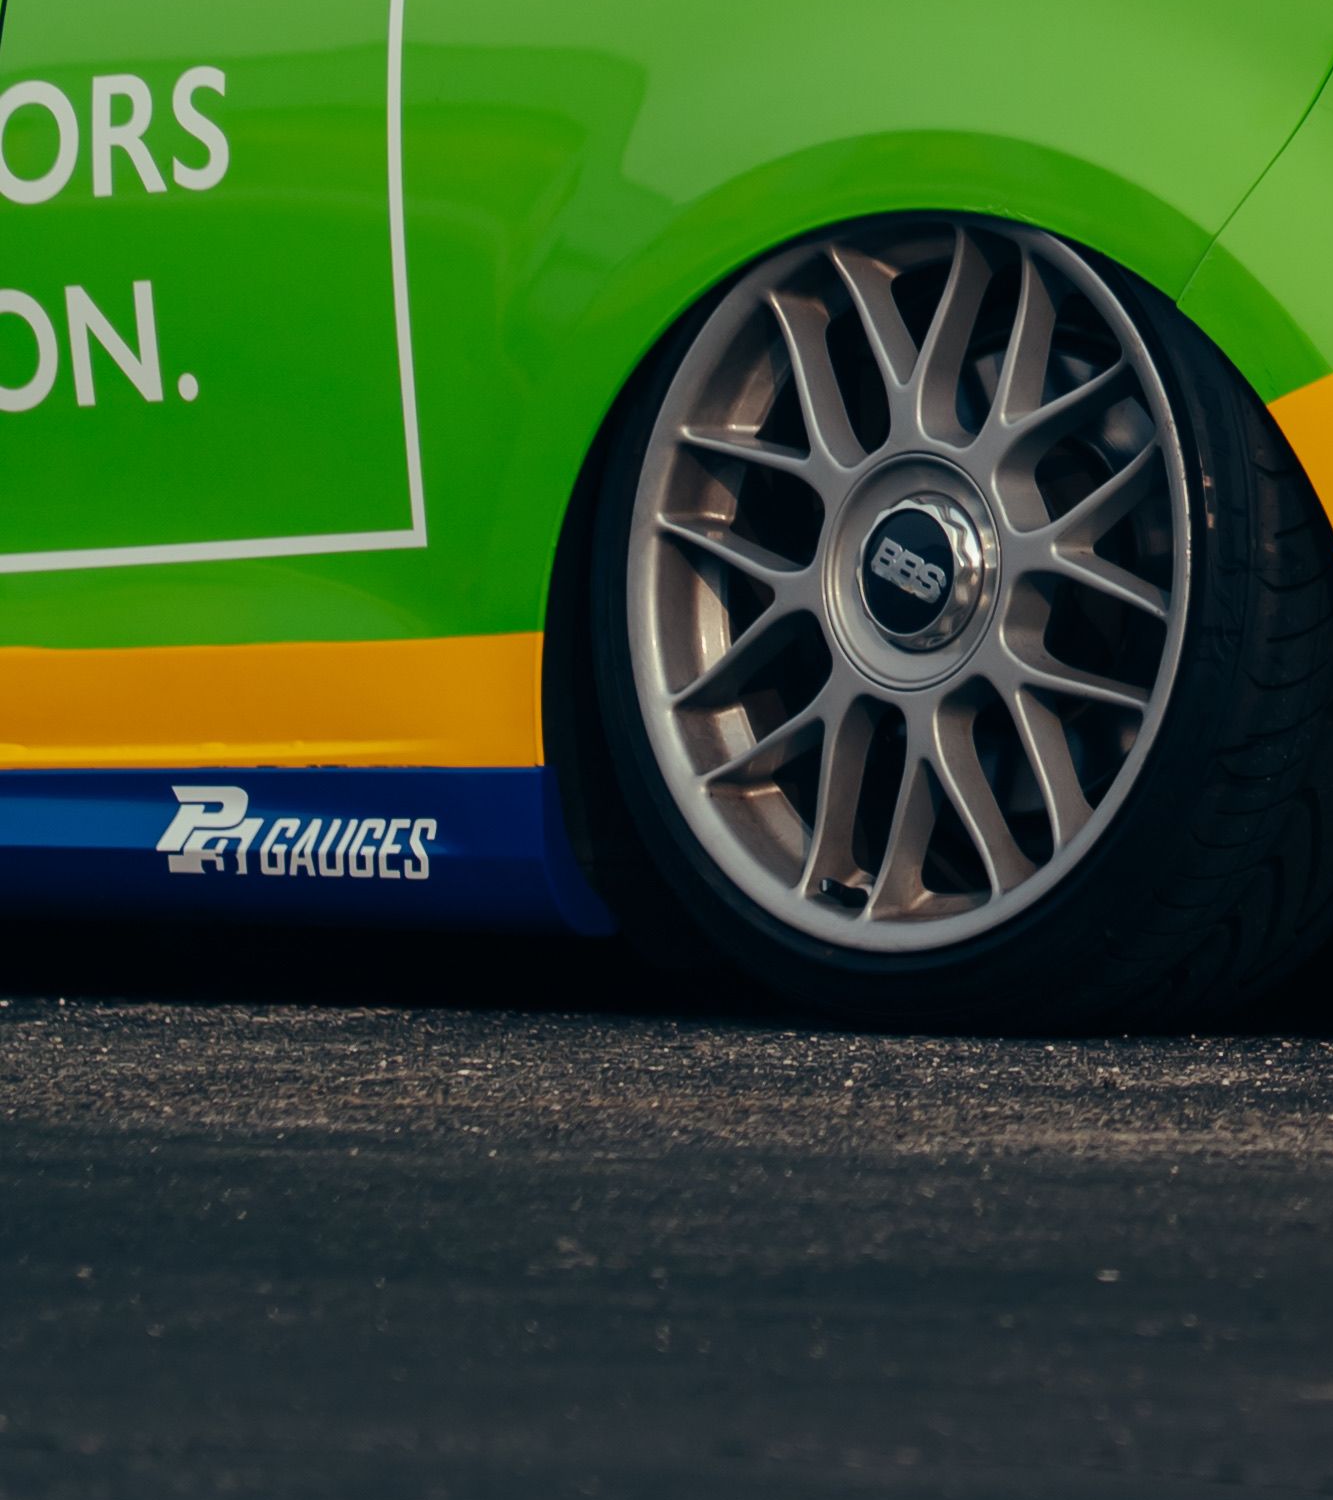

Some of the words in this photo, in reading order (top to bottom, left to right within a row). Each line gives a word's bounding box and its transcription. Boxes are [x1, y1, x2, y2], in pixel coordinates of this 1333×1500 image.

[0, 66, 230, 204] ORS
[0, 279, 199, 412] ON.
[871, 537, 947, 604] BBS
[260, 817, 437, 880] GAUGES
